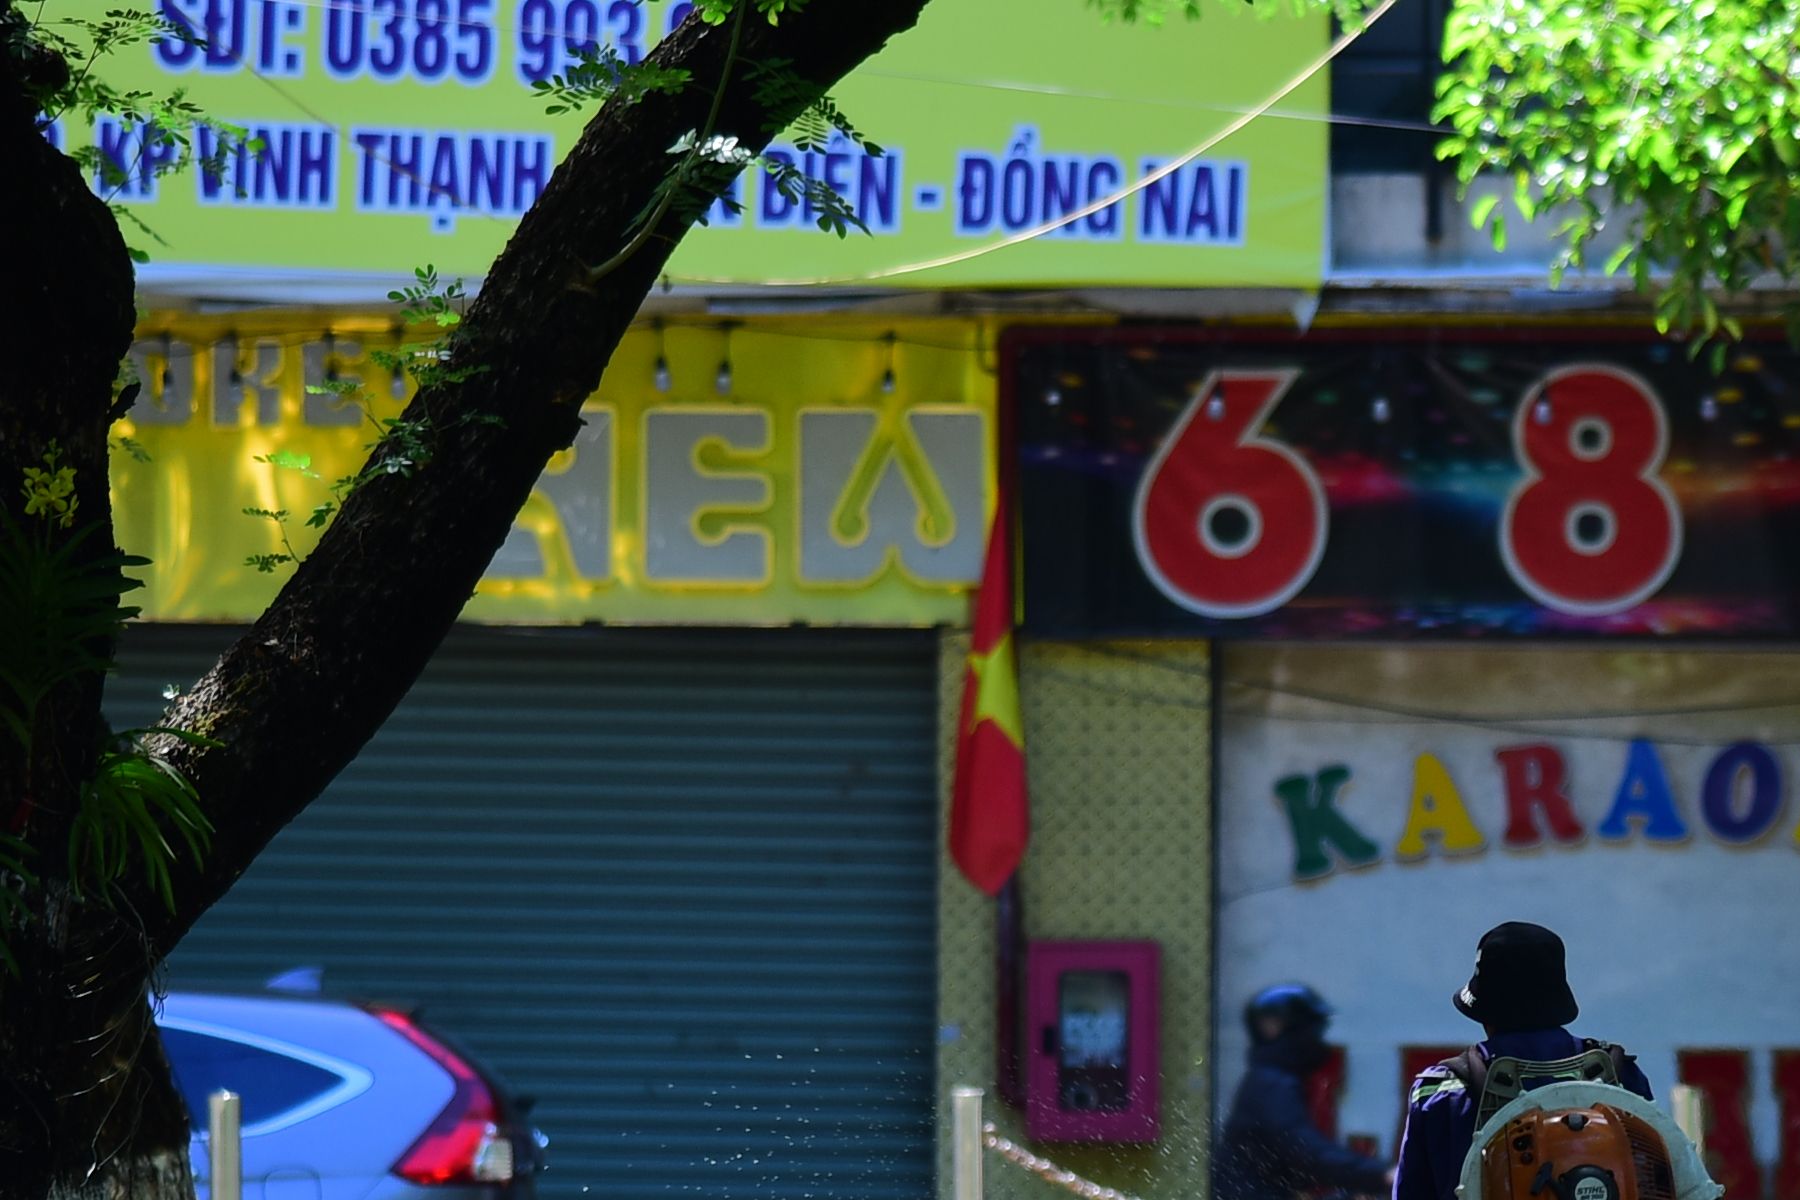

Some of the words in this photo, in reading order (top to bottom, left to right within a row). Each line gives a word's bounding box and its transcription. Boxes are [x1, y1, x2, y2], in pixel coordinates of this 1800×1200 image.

[328, 0, 491, 79] 0385
[356, 134, 546, 226] THẠNH
[1143, 163, 1240, 236] NAI
[1577, 1185, 1605, 1195] STIHL
